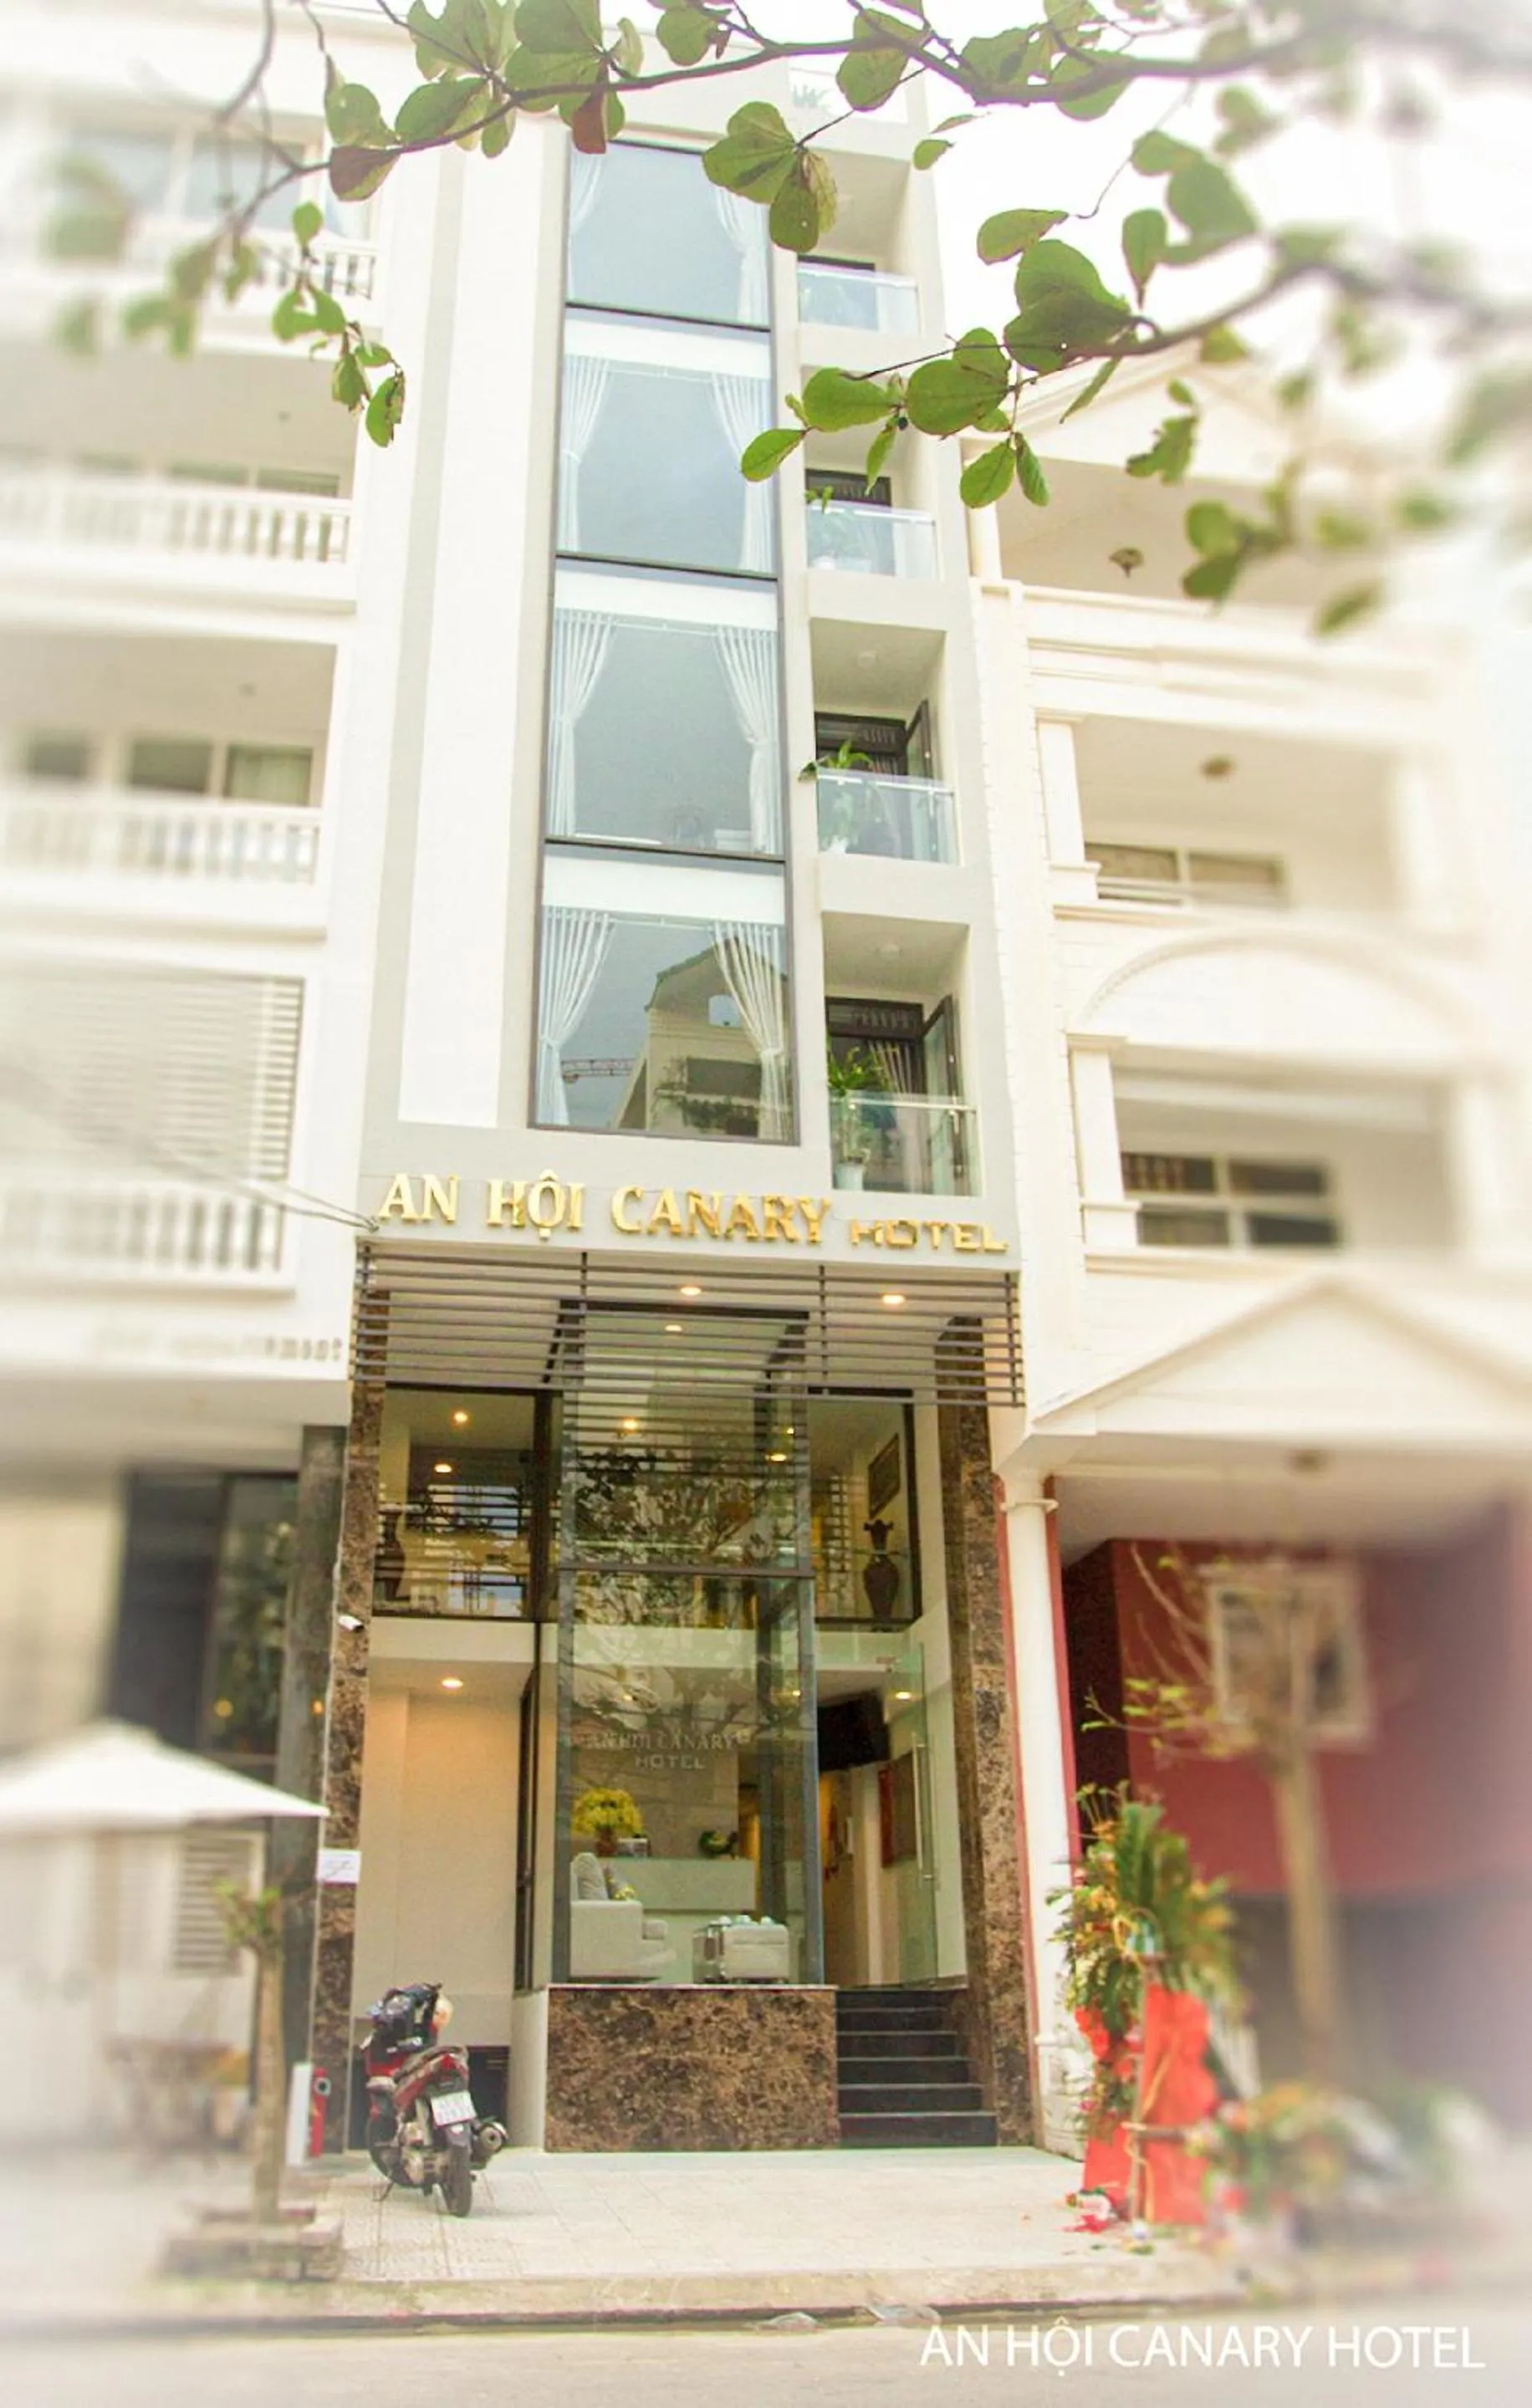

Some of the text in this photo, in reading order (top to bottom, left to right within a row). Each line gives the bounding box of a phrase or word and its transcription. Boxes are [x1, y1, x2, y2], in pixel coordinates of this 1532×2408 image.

[379, 1169, 1009, 1254] AN HỘI CANARY HOTEL
[656, 1731, 733, 1750] CANARY
[636, 1754, 706, 1769] HOTEL
